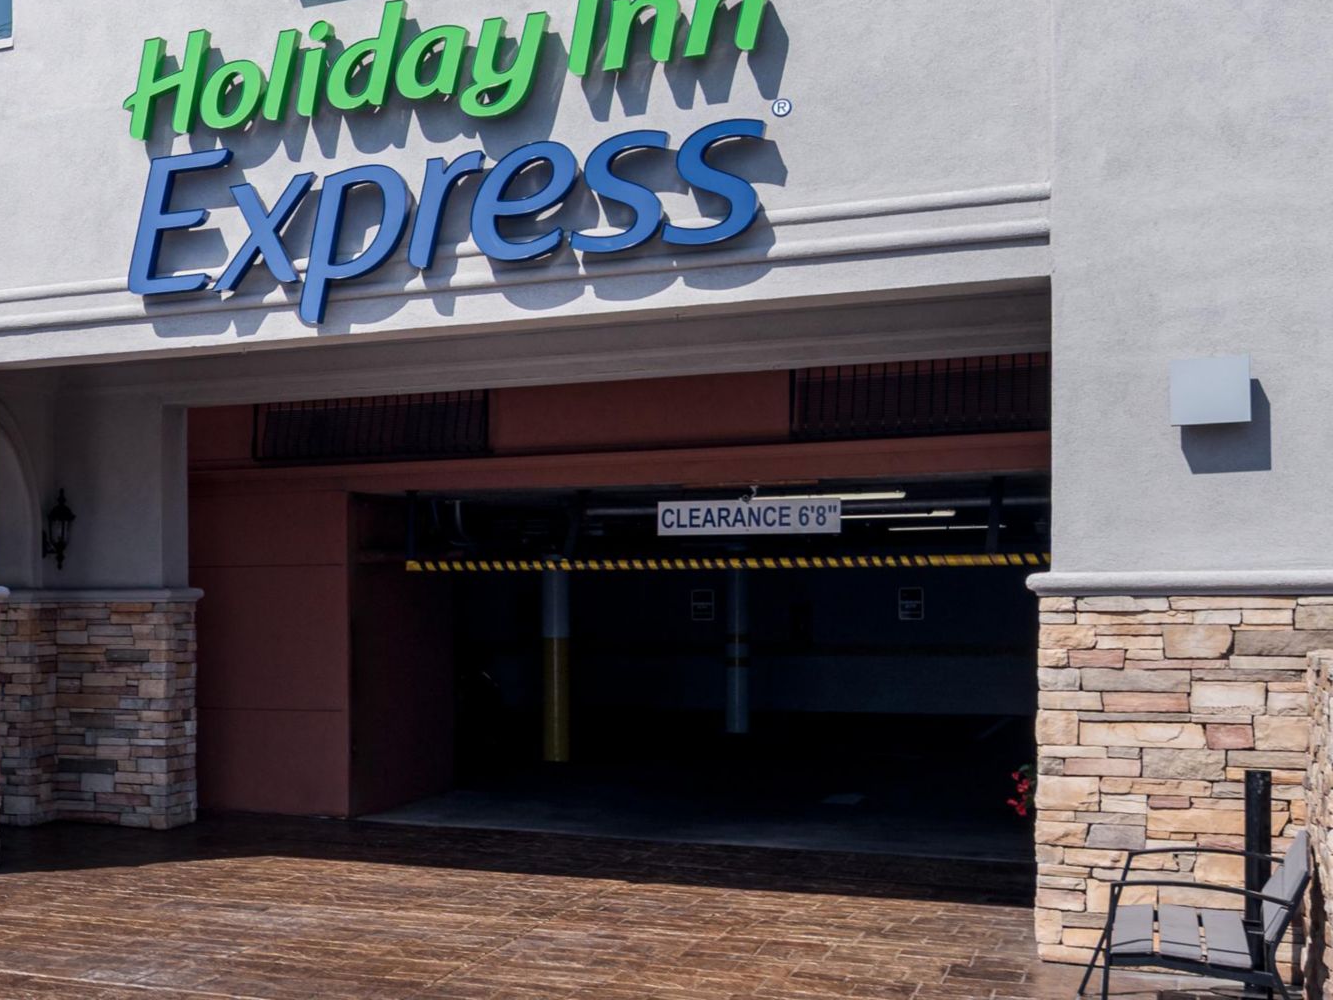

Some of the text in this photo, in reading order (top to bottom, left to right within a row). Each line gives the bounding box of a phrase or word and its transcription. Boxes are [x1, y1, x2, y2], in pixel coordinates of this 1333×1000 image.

[123, 0, 550, 141] Holiday
[127, 118, 767, 325] Express
[661, 505, 837, 528] CLEARANCE 6'8"
